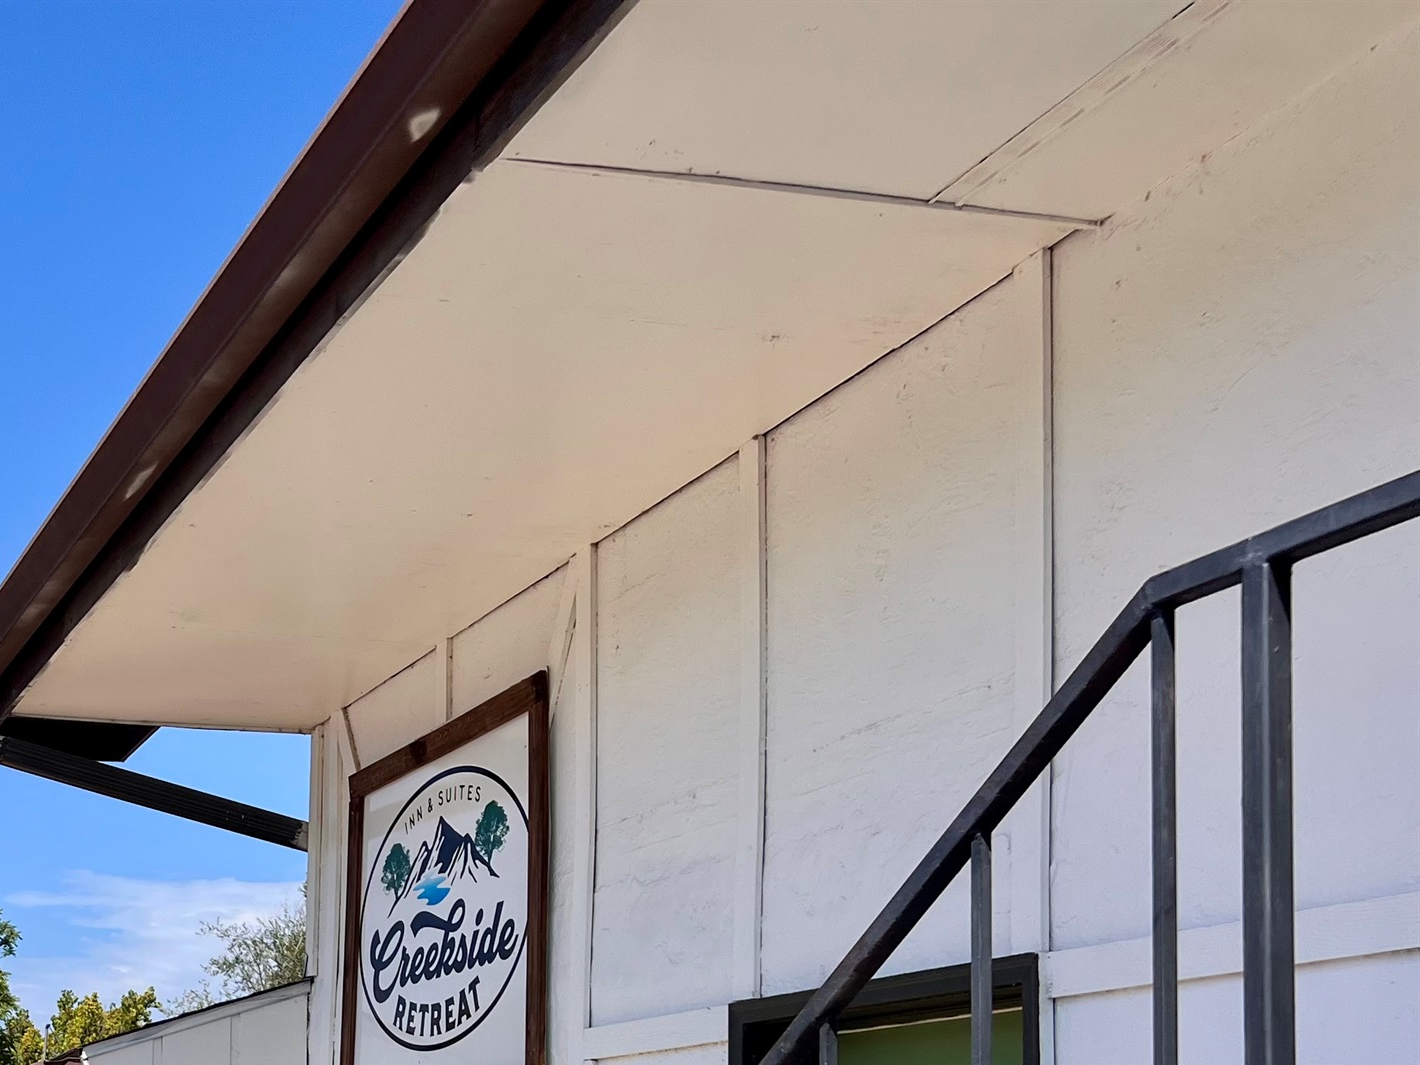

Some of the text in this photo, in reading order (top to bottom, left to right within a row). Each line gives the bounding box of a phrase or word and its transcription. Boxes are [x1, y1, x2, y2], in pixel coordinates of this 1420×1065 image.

[404, 784, 482, 835] INN & SUITES
[370, 898, 519, 1004] Creekside
[392, 975, 481, 1037] RETREAT
